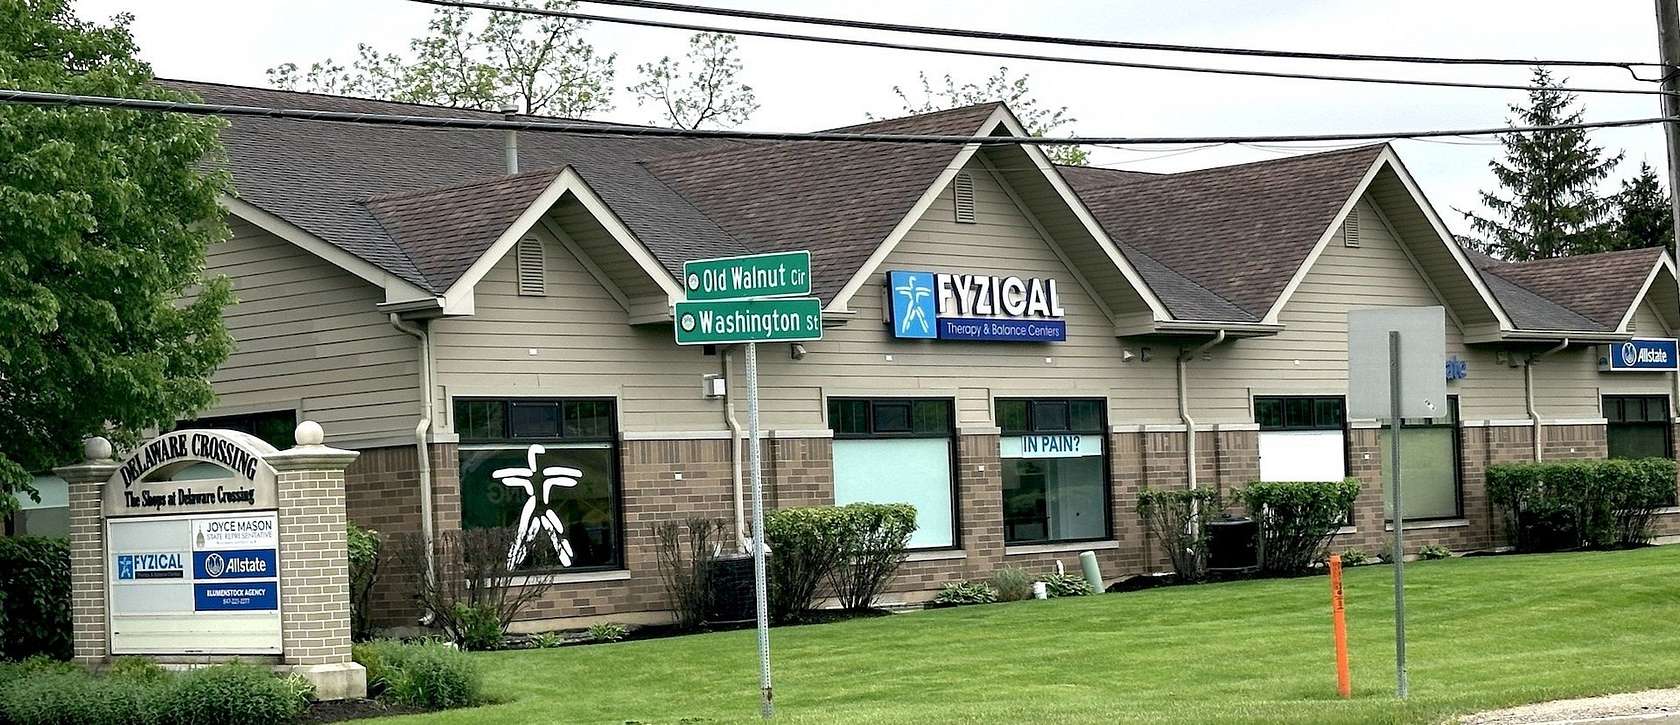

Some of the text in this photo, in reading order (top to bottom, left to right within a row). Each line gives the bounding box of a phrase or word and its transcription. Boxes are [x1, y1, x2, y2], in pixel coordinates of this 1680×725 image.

[703, 263, 805, 292] Old Walnut Cir
[937, 273, 1065, 317] FYZICAL
[699, 309, 819, 338] Washington St
[947, 322, 1060, 337] Therapy & Balance Centers
[1637, 347, 1668, 363] Allstate
[1023, 435, 1081, 453] IN PAIN?
[119, 433, 258, 489] DELAWARE CROSSING
[124, 485, 255, 511] The Shops at Delaware Crossing
[207, 520, 272, 532] JOYCE MASON
[135, 553, 183, 570] FYZICAL
[225, 557, 267, 573] Allstate
[245, 588, 266, 596] AGENCY
